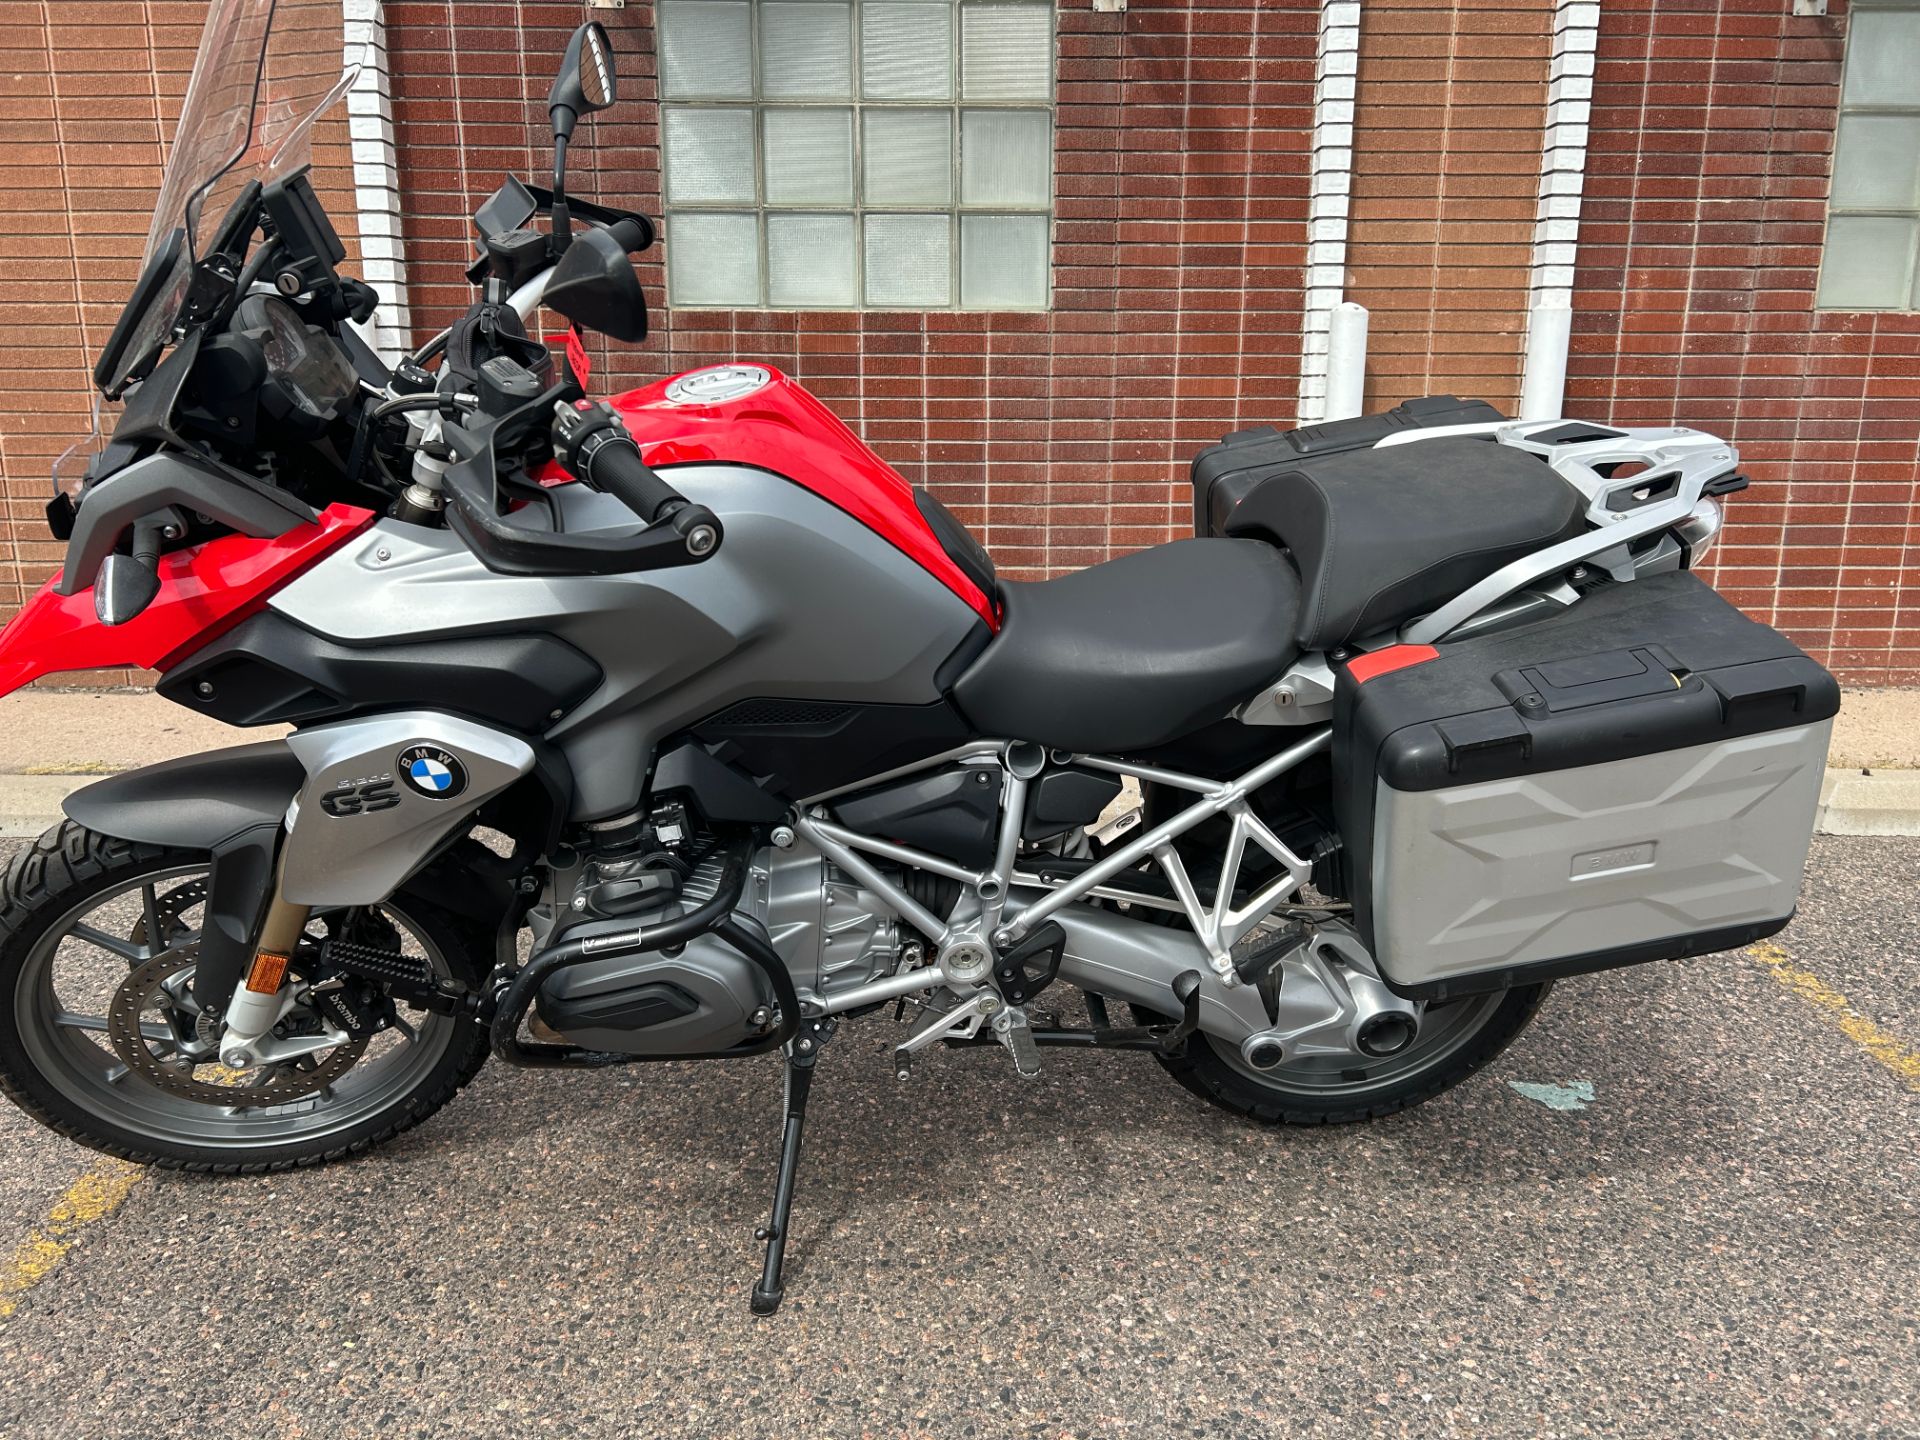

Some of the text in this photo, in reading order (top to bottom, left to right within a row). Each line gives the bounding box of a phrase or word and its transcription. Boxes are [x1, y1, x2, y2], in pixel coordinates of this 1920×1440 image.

[400, 748, 453, 769] BMW
[319, 780, 402, 818] GS
[328, 993, 361, 1030] brembo
